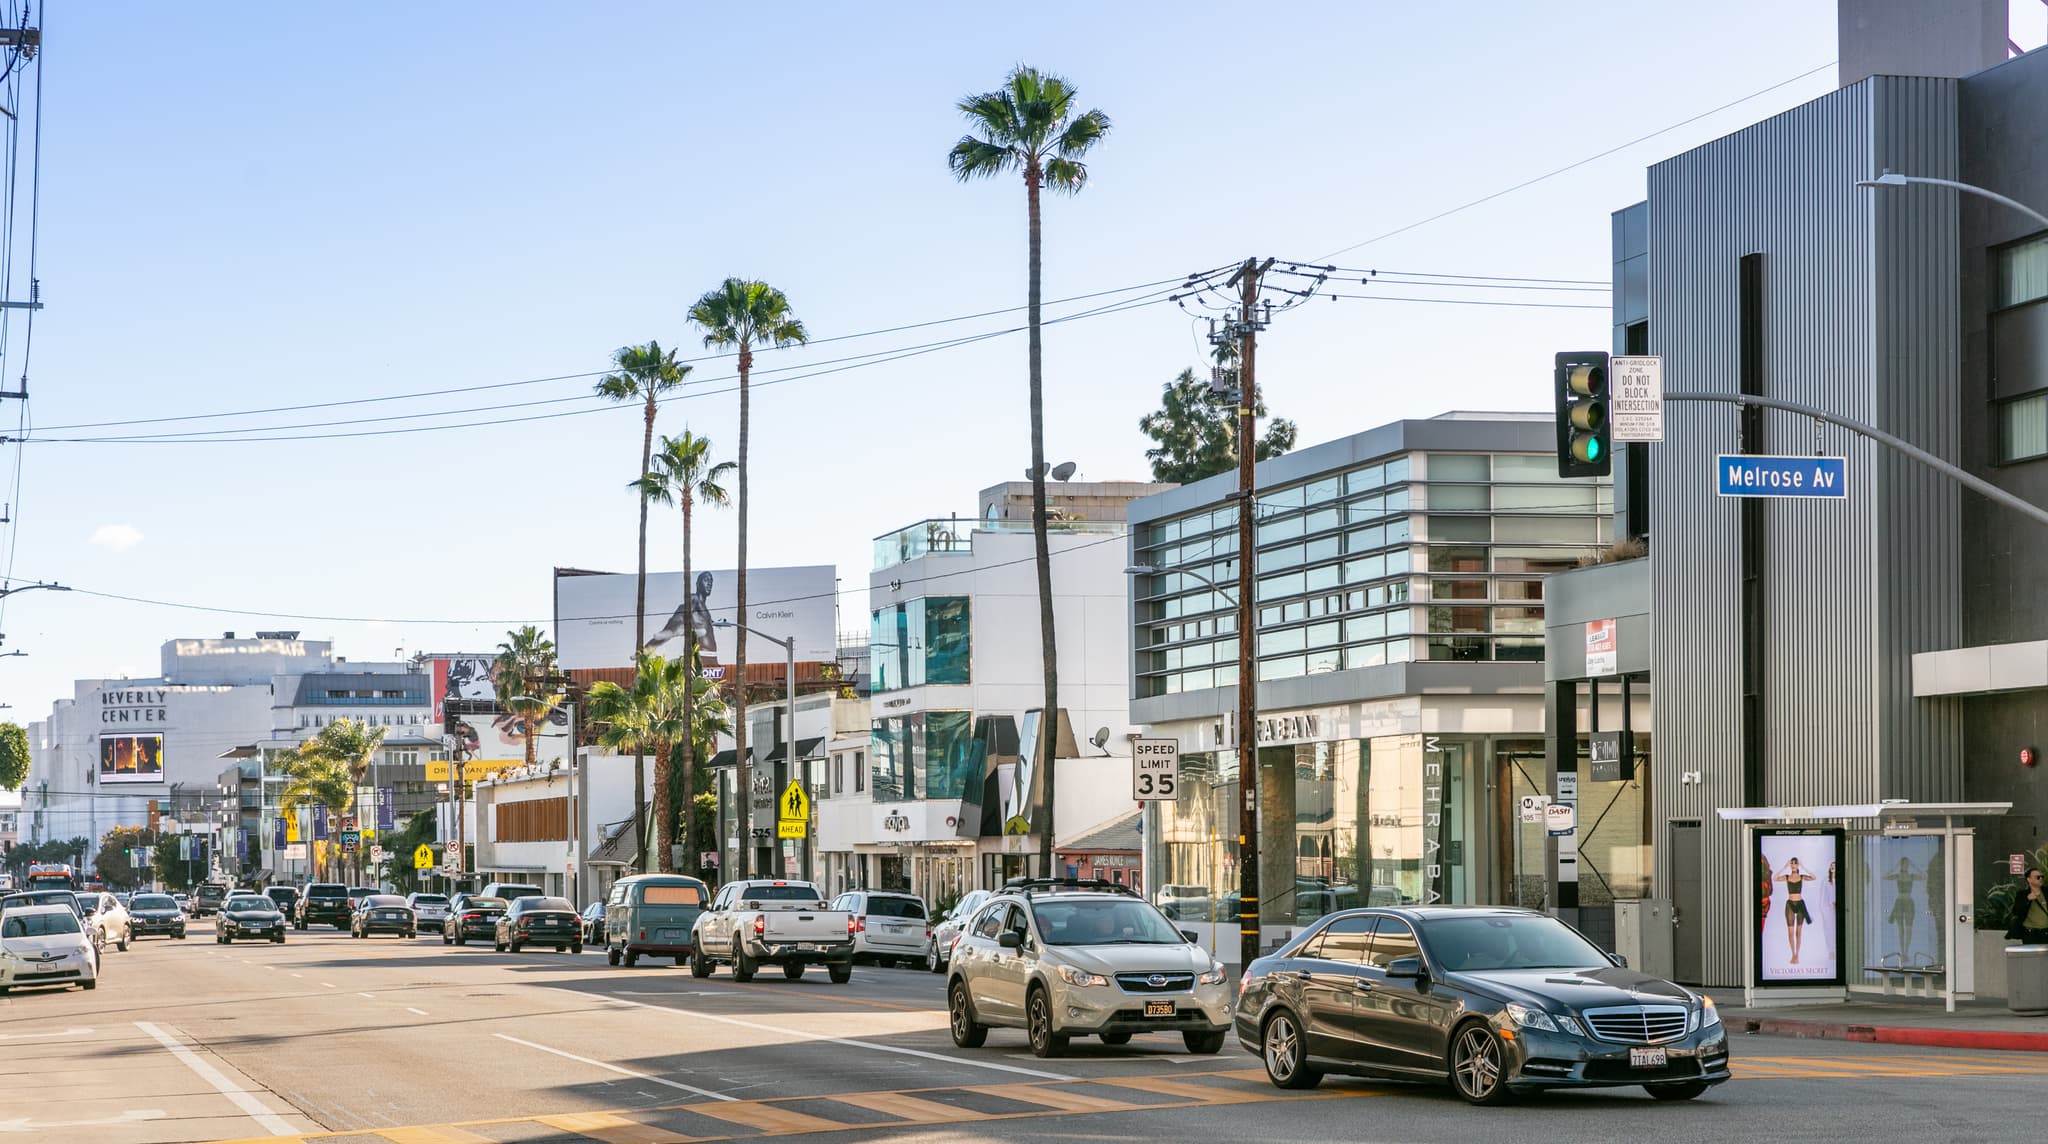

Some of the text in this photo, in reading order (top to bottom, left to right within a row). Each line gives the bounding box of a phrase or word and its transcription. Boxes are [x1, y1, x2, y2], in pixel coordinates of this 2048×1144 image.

[1622, 375, 1650, 386] DO NOT
[1624, 387, 1649, 398] BLOCK
[1614, 400, 1660, 411] INTERSECTION
[1728, 465, 1835, 488] Melrose Av
[755, 611, 777, 620] Calvin
[102, 690, 167, 705] BEVERLY
[102, 708, 167, 723] CENTER
[1136, 745, 1175, 755] SPEED
[1140, 759, 1171, 769] LIMIT
[1138, 773, 1175, 795] 35
[752, 828, 771, 839] 525
[781, 825, 803, 834] AHEAD
